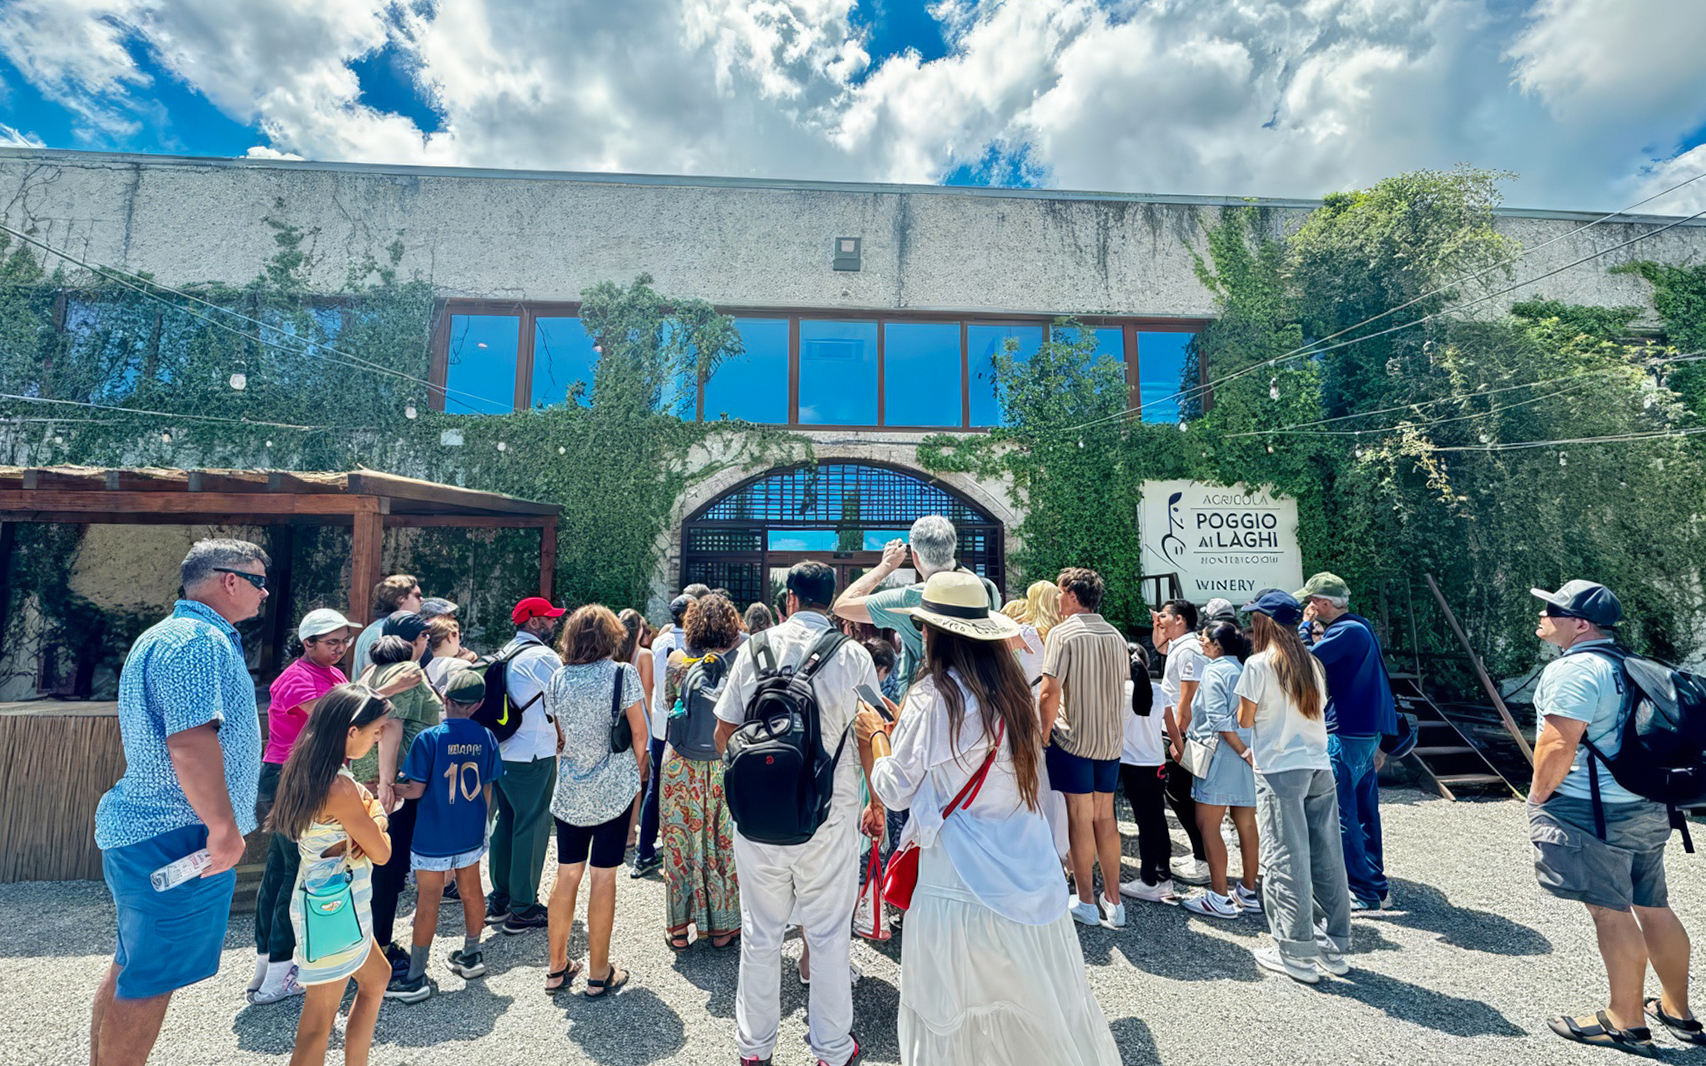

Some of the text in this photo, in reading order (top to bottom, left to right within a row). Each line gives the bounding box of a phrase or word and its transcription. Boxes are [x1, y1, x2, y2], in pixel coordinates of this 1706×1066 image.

[1196, 512, 1278, 530] POGGIO
[1198, 530, 1278, 548] AI LAGHI
[1195, 578, 1256, 591] WINERY
[443, 761, 482, 804] 10
